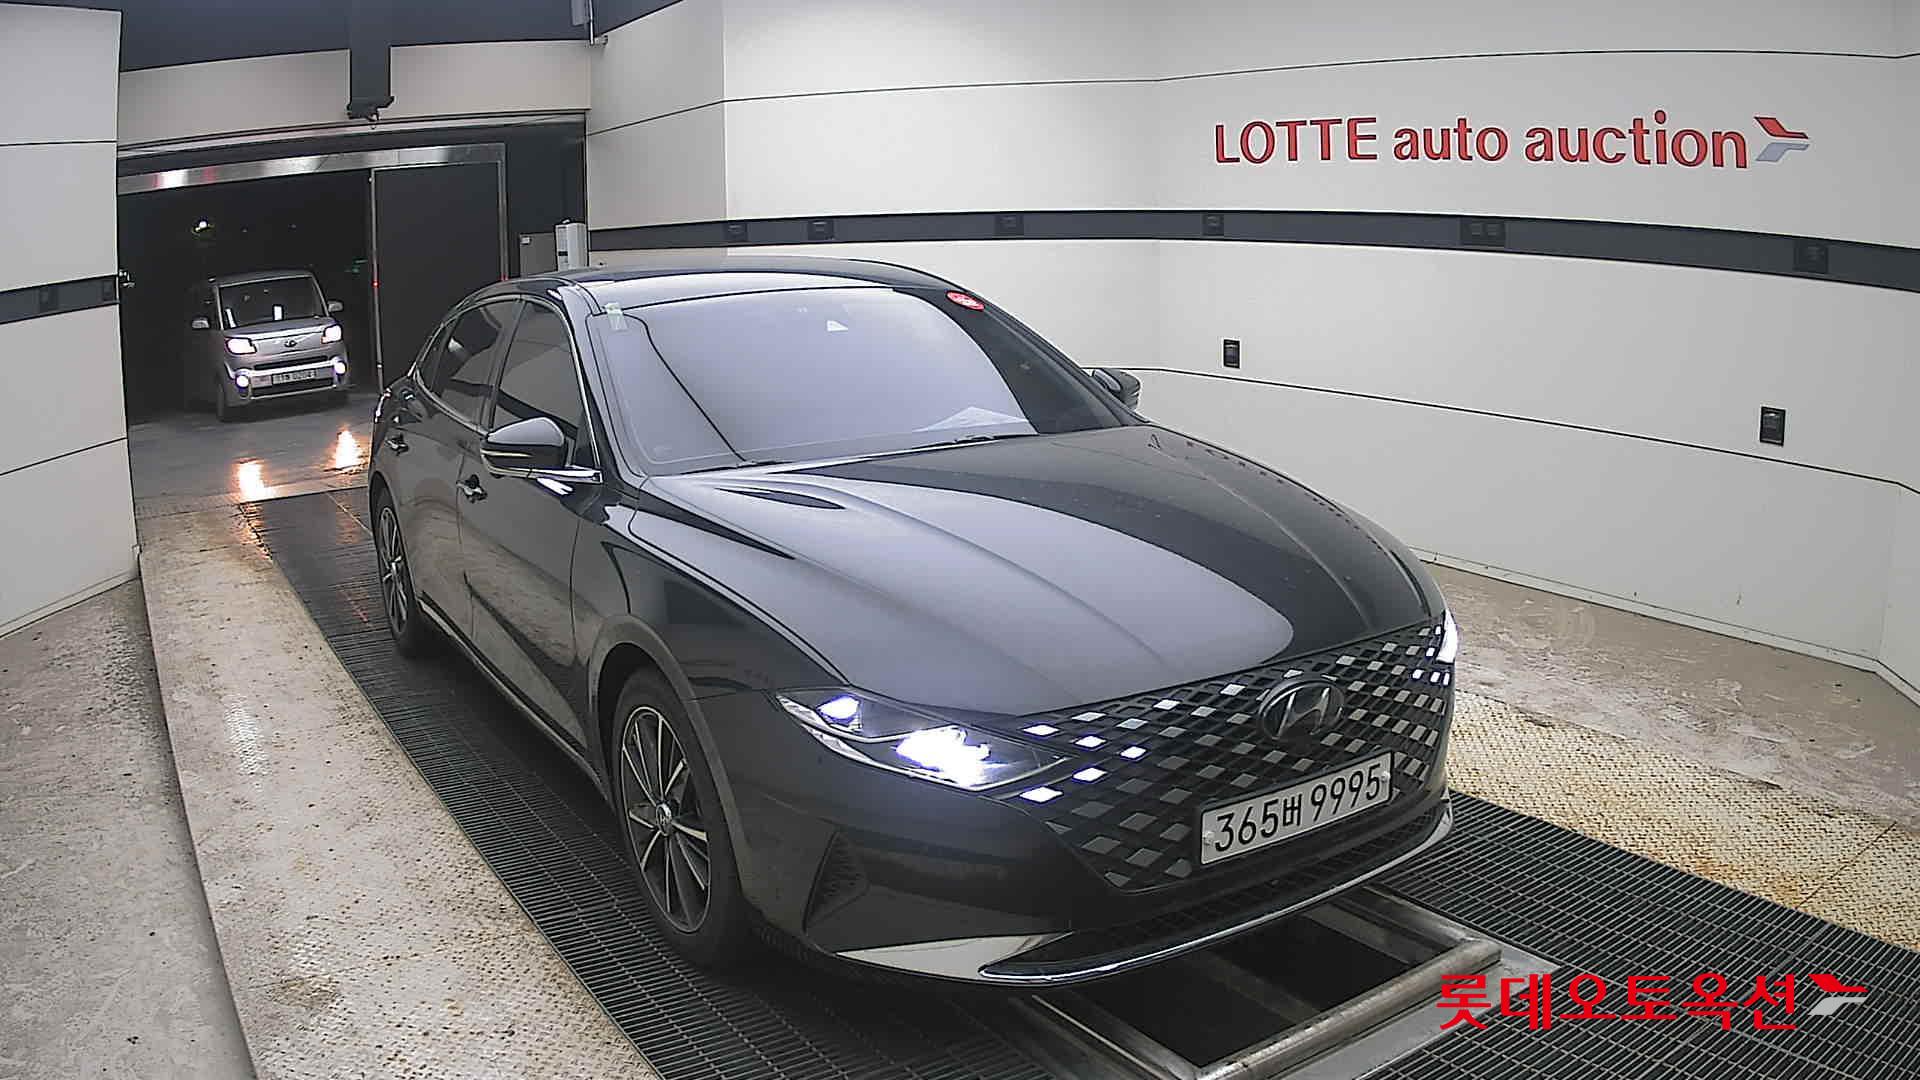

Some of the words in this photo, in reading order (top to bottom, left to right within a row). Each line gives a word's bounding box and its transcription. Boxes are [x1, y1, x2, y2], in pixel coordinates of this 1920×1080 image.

[1216, 118, 1377, 163] LOTTE
[1394, 118, 1509, 162] auto
[1525, 110, 1748, 168] auction
[1214, 793, 1303, 853] 365버
[1310, 762, 1383, 823] 9995
